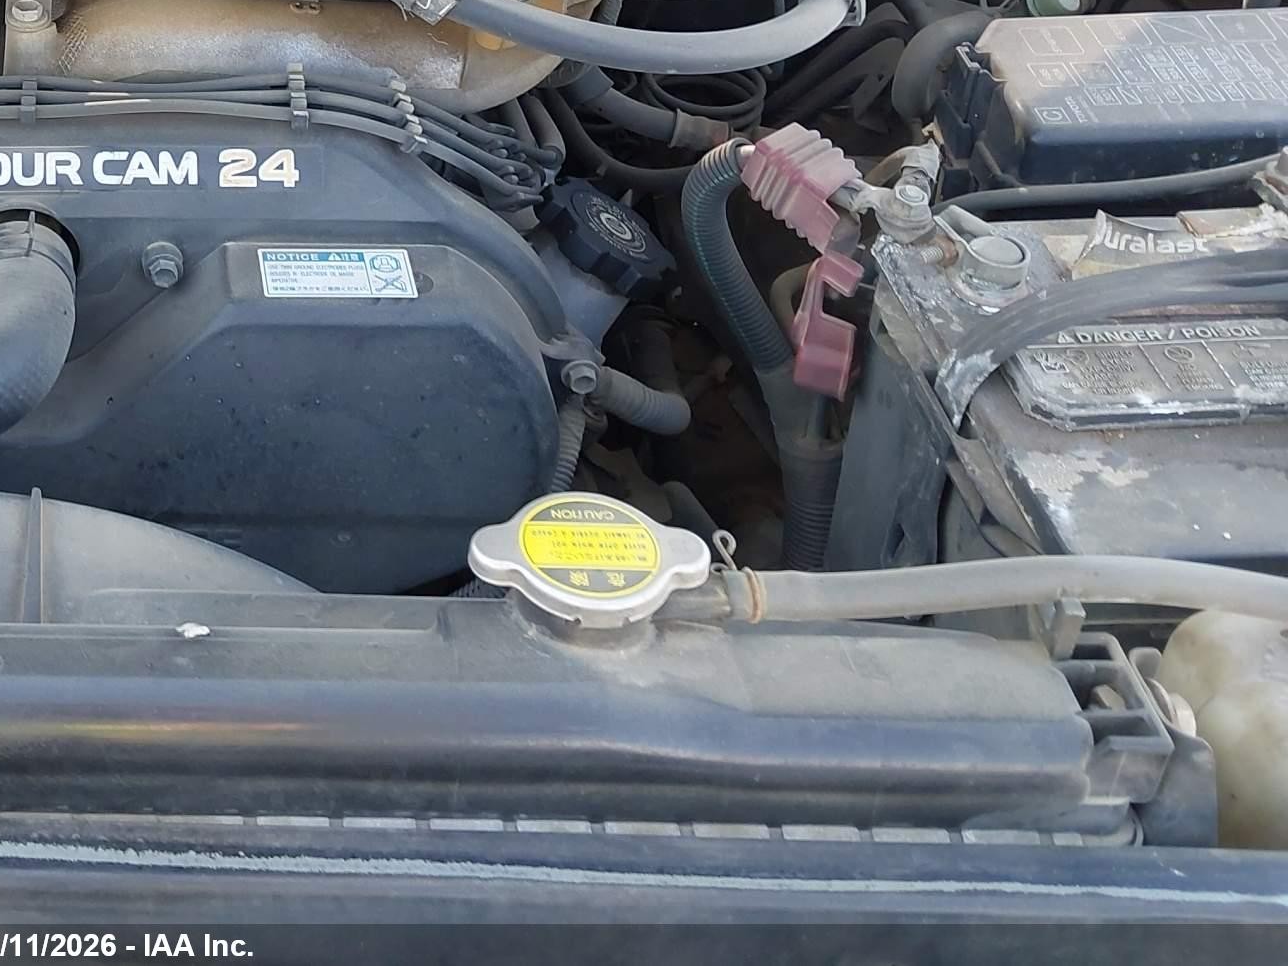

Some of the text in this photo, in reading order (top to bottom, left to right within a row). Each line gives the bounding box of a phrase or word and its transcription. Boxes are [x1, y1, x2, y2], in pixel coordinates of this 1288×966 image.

[93, 150, 199, 186] CAM
[217, 149, 300, 187] 24
[266, 252, 320, 261] NOTICE
[1074, 328, 1164, 344] DANGER
[551, 508, 615, 521] CAUTION
